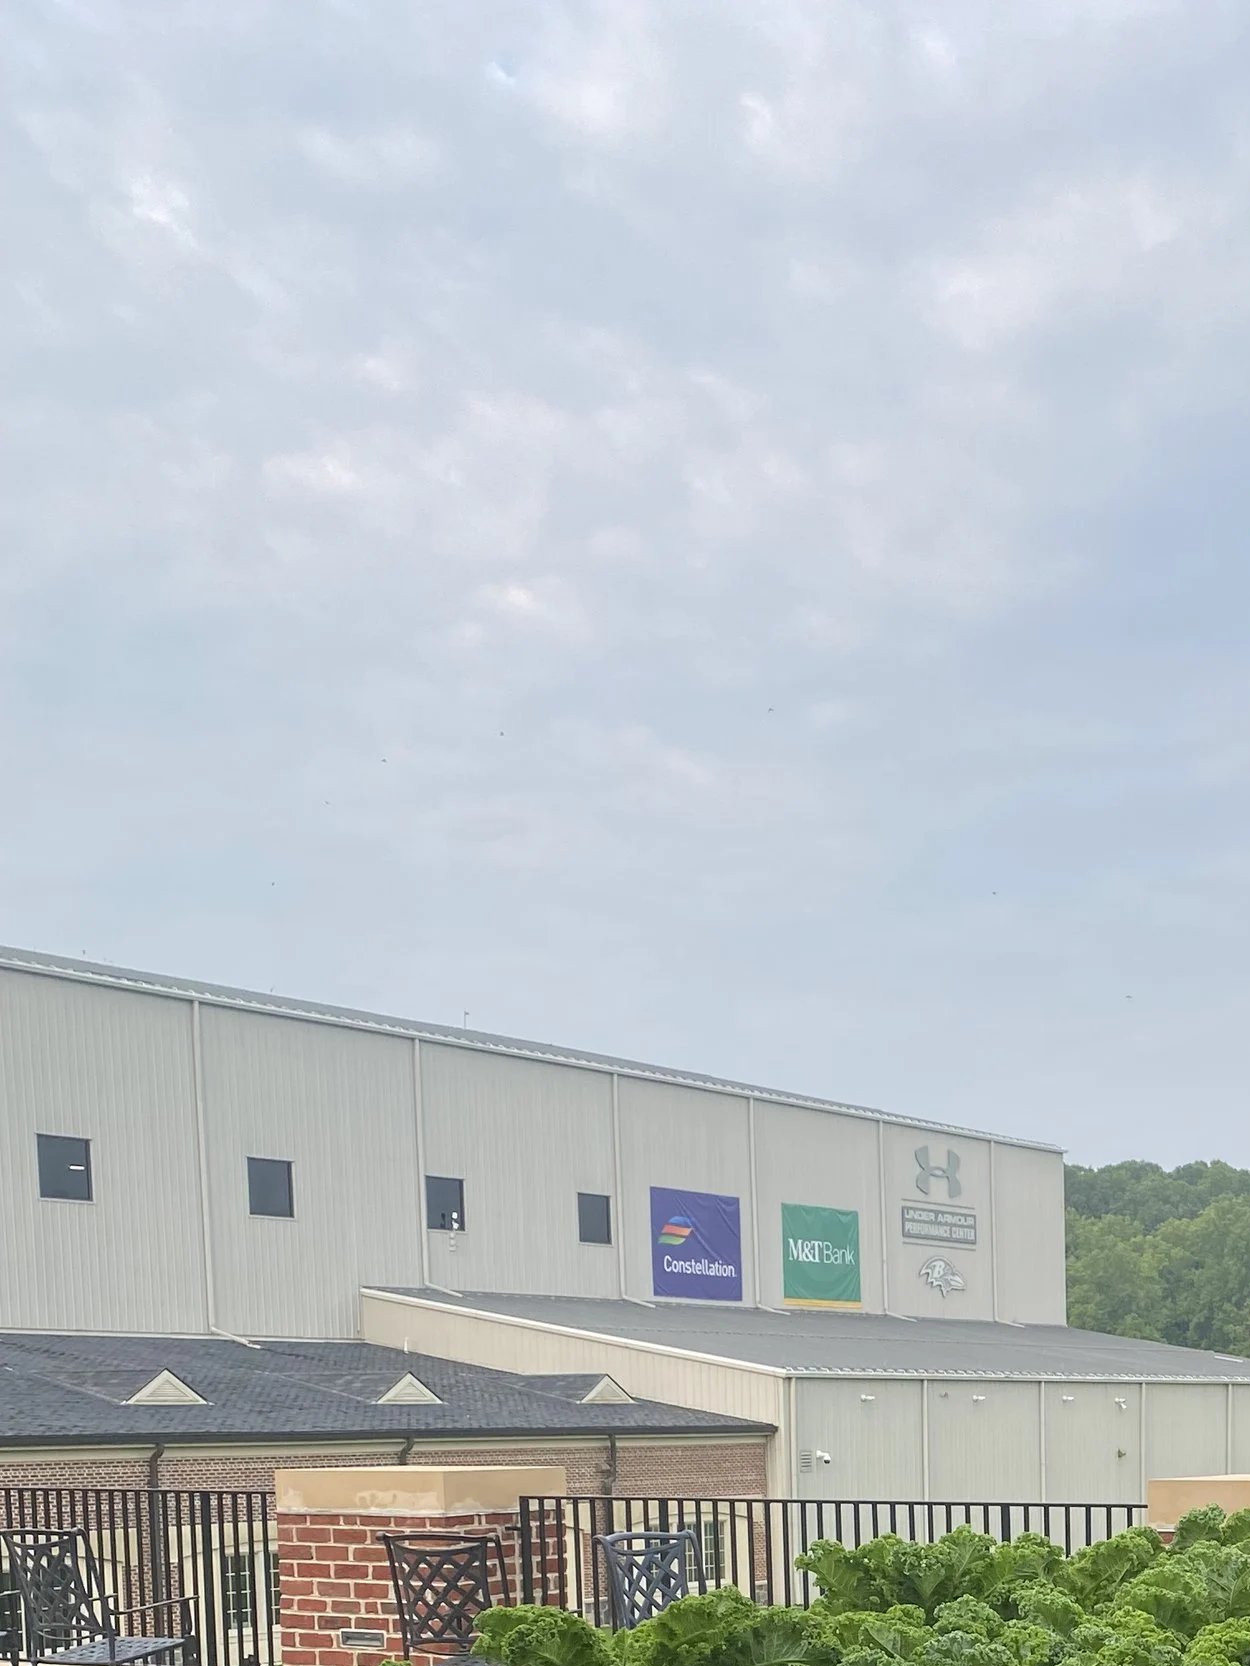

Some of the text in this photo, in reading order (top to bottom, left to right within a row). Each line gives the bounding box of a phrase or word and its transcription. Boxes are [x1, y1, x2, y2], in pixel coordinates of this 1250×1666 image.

[904, 1208, 974, 1226] UNDER ARMOUR
[788, 1238, 855, 1265] M&T Bank
[663, 1255, 735, 1278] Constellation
